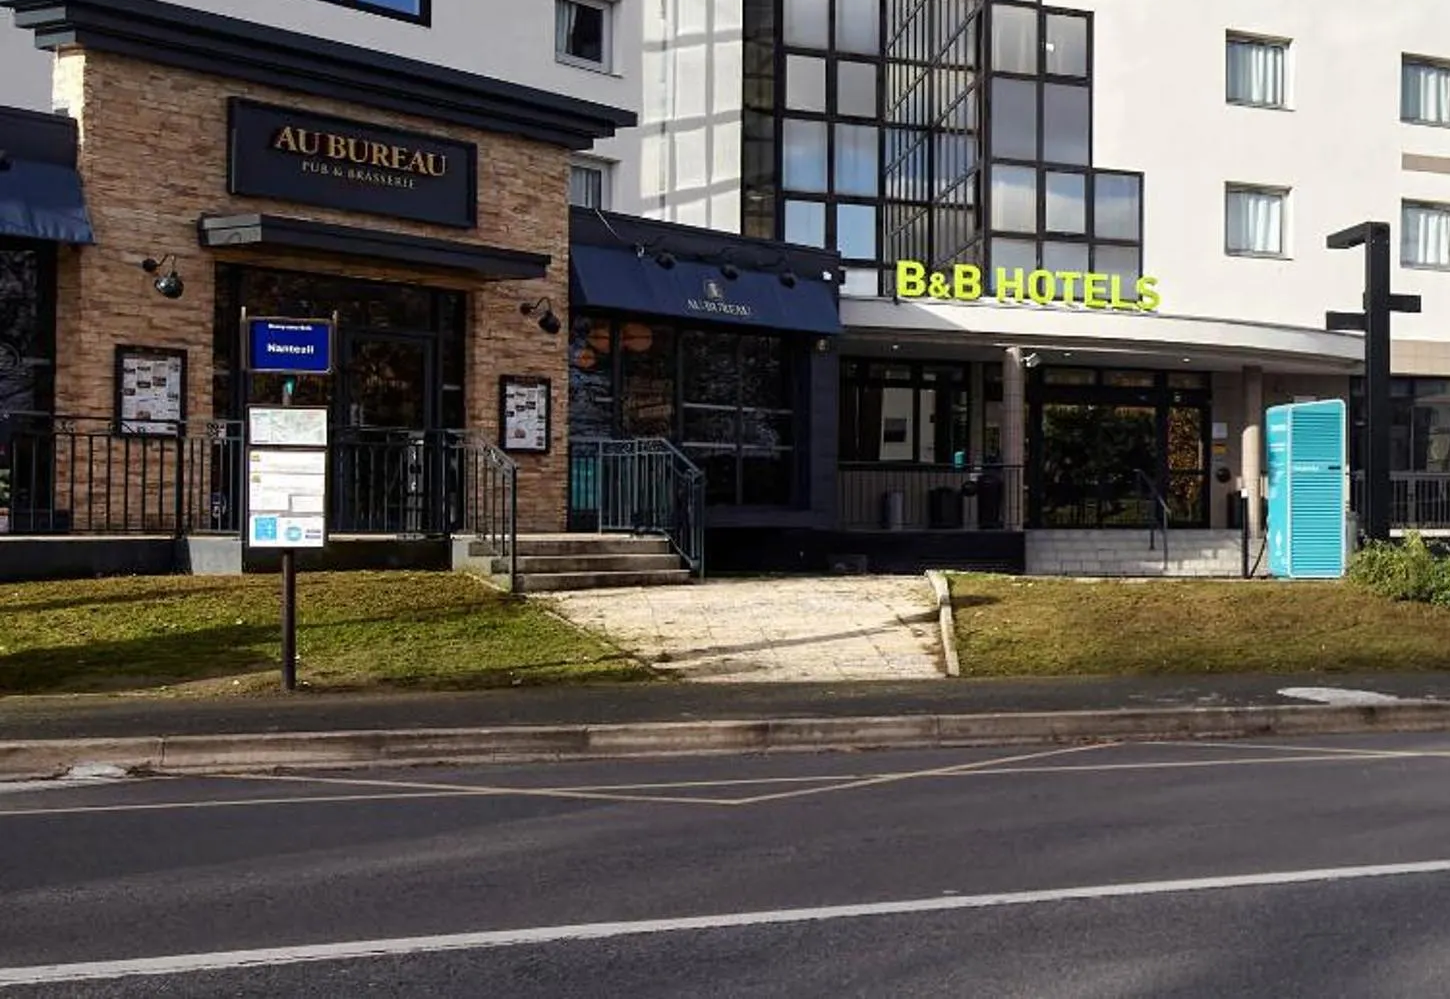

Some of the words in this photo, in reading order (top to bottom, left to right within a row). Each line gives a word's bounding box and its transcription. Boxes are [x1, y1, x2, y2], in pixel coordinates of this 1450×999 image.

[274, 126, 320, 155] AU
[327, 133, 448, 177] BUREAU
[302, 160, 328, 175] PUB
[333, 165, 343, 177] &
[347, 170, 416, 190] BRASSERIE
[896, 259, 982, 301] B&B
[996, 267, 1161, 312] HOTELS
